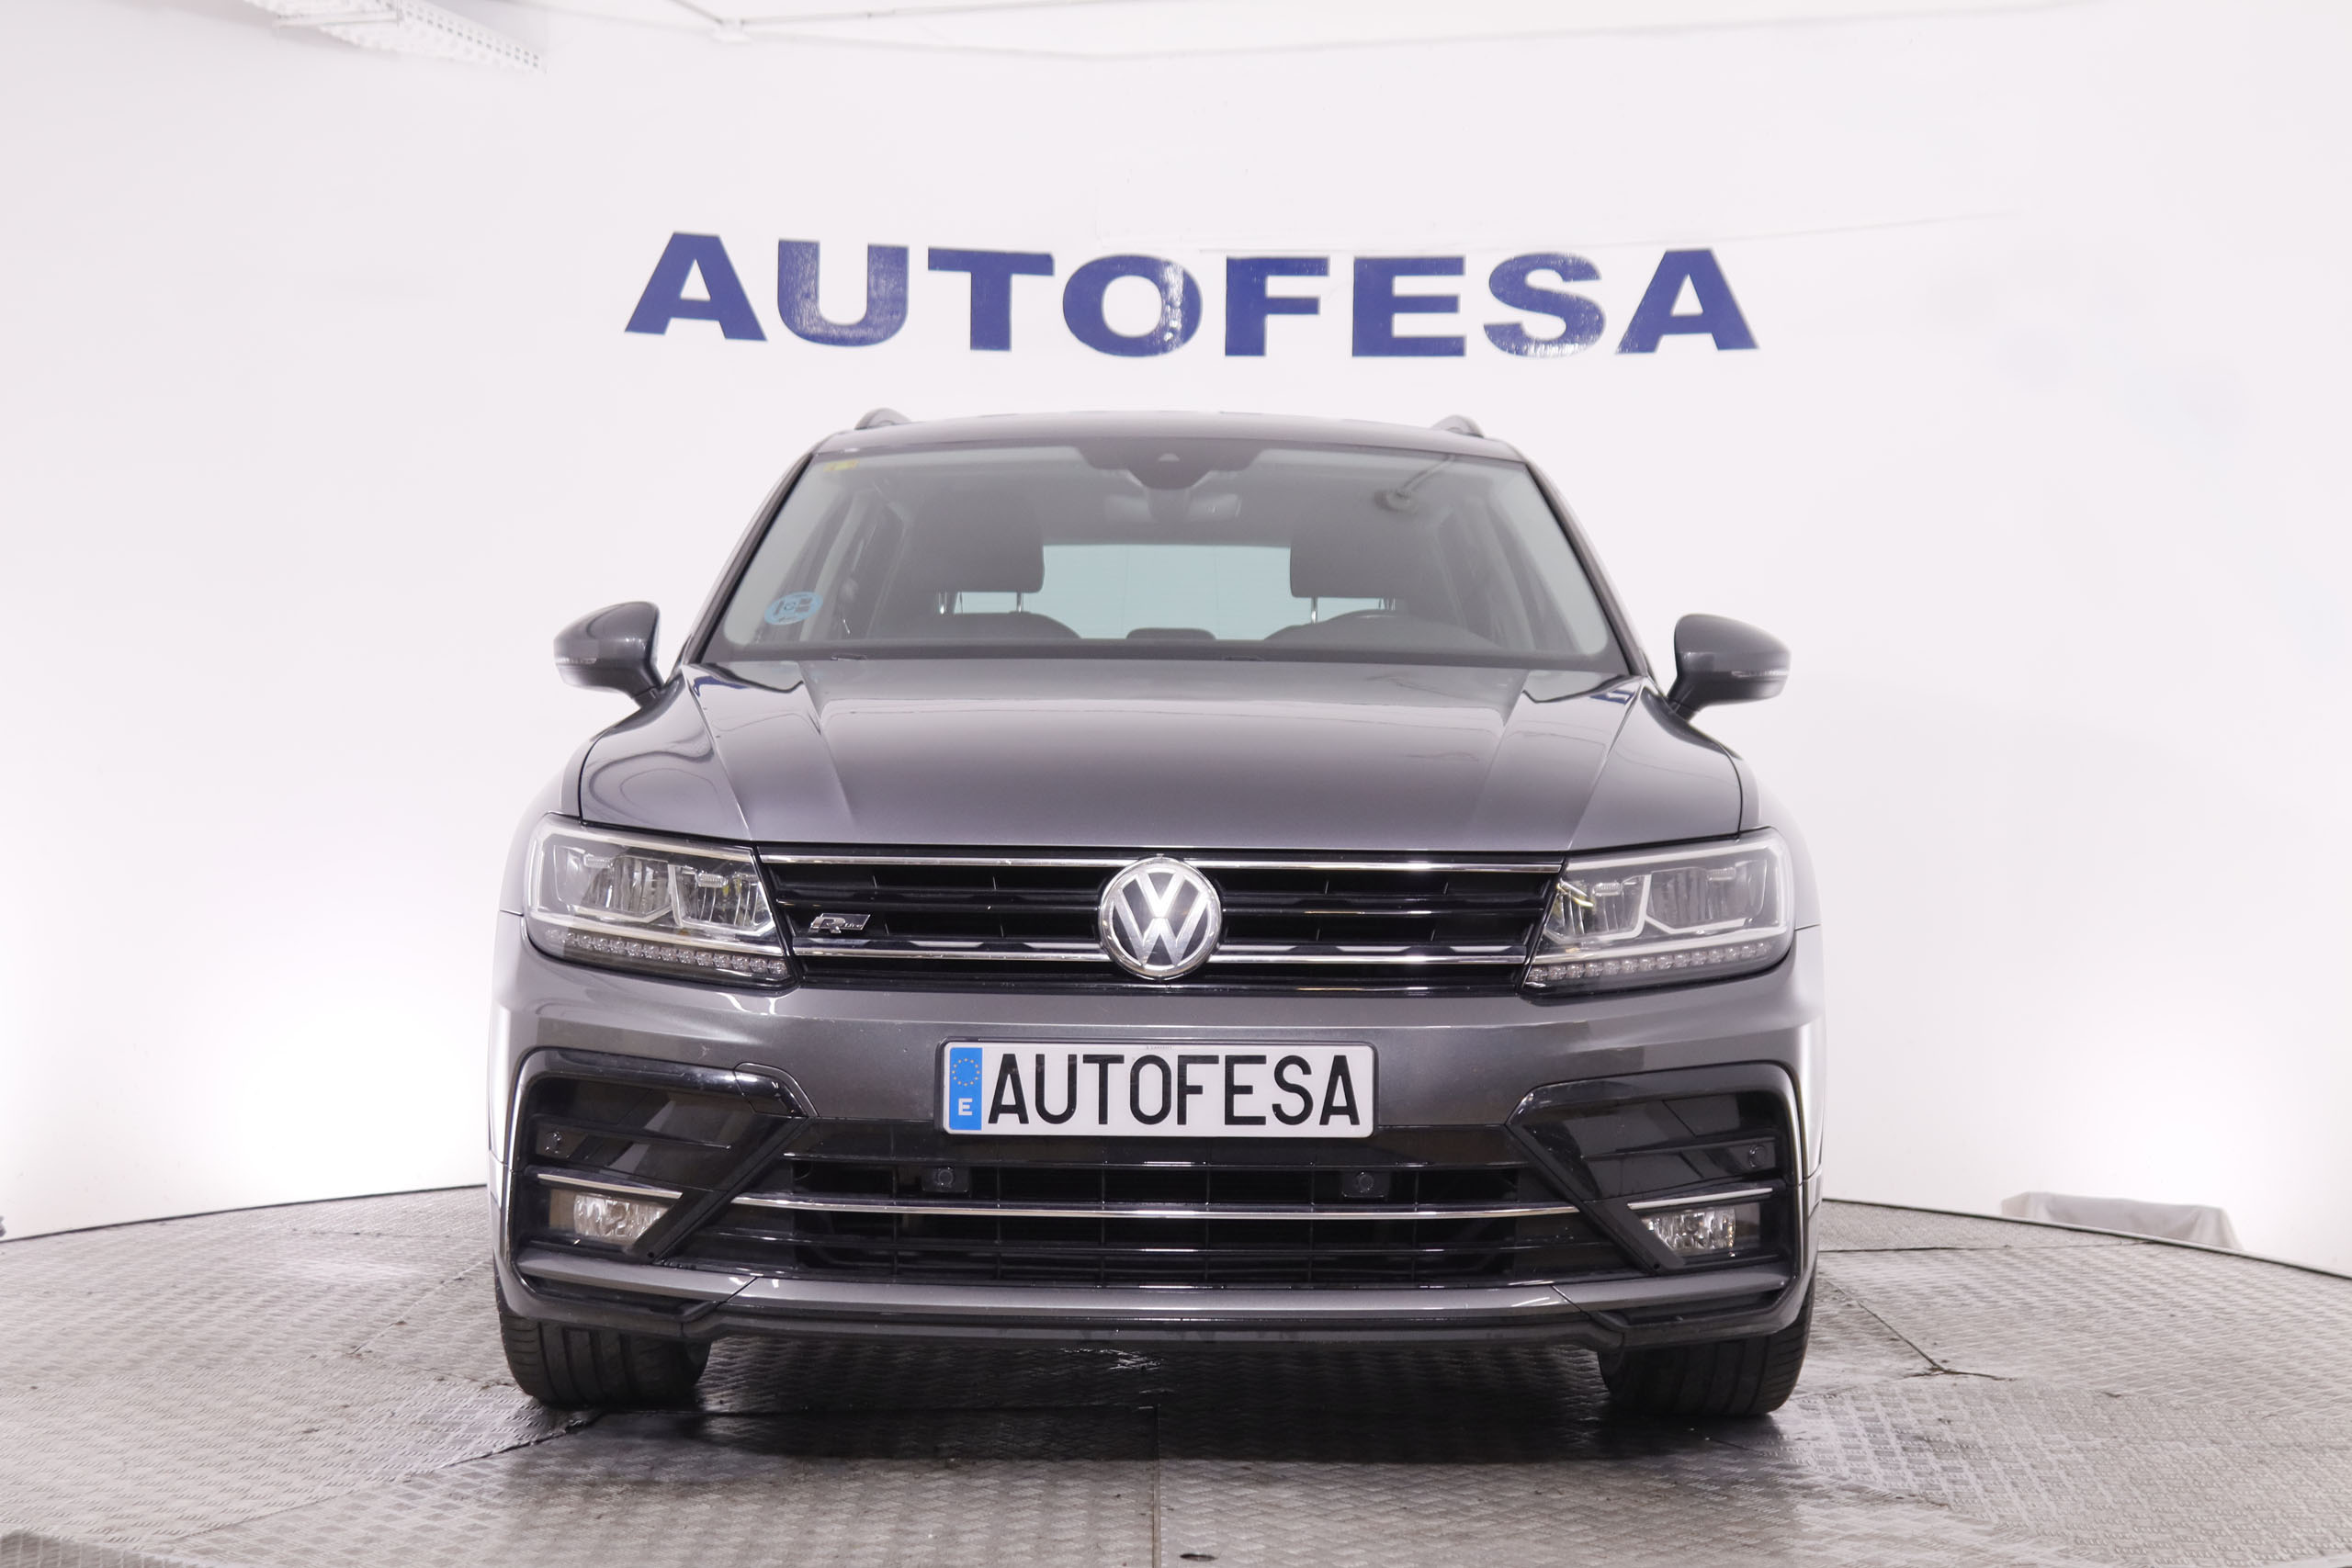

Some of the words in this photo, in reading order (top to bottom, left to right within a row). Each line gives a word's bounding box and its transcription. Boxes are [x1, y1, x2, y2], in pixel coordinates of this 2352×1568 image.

[625, 232, 1758, 358] AUTOFESA
[958, 1098, 973, 1116] E
[988, 1054, 1360, 1125] AUTOFESA
